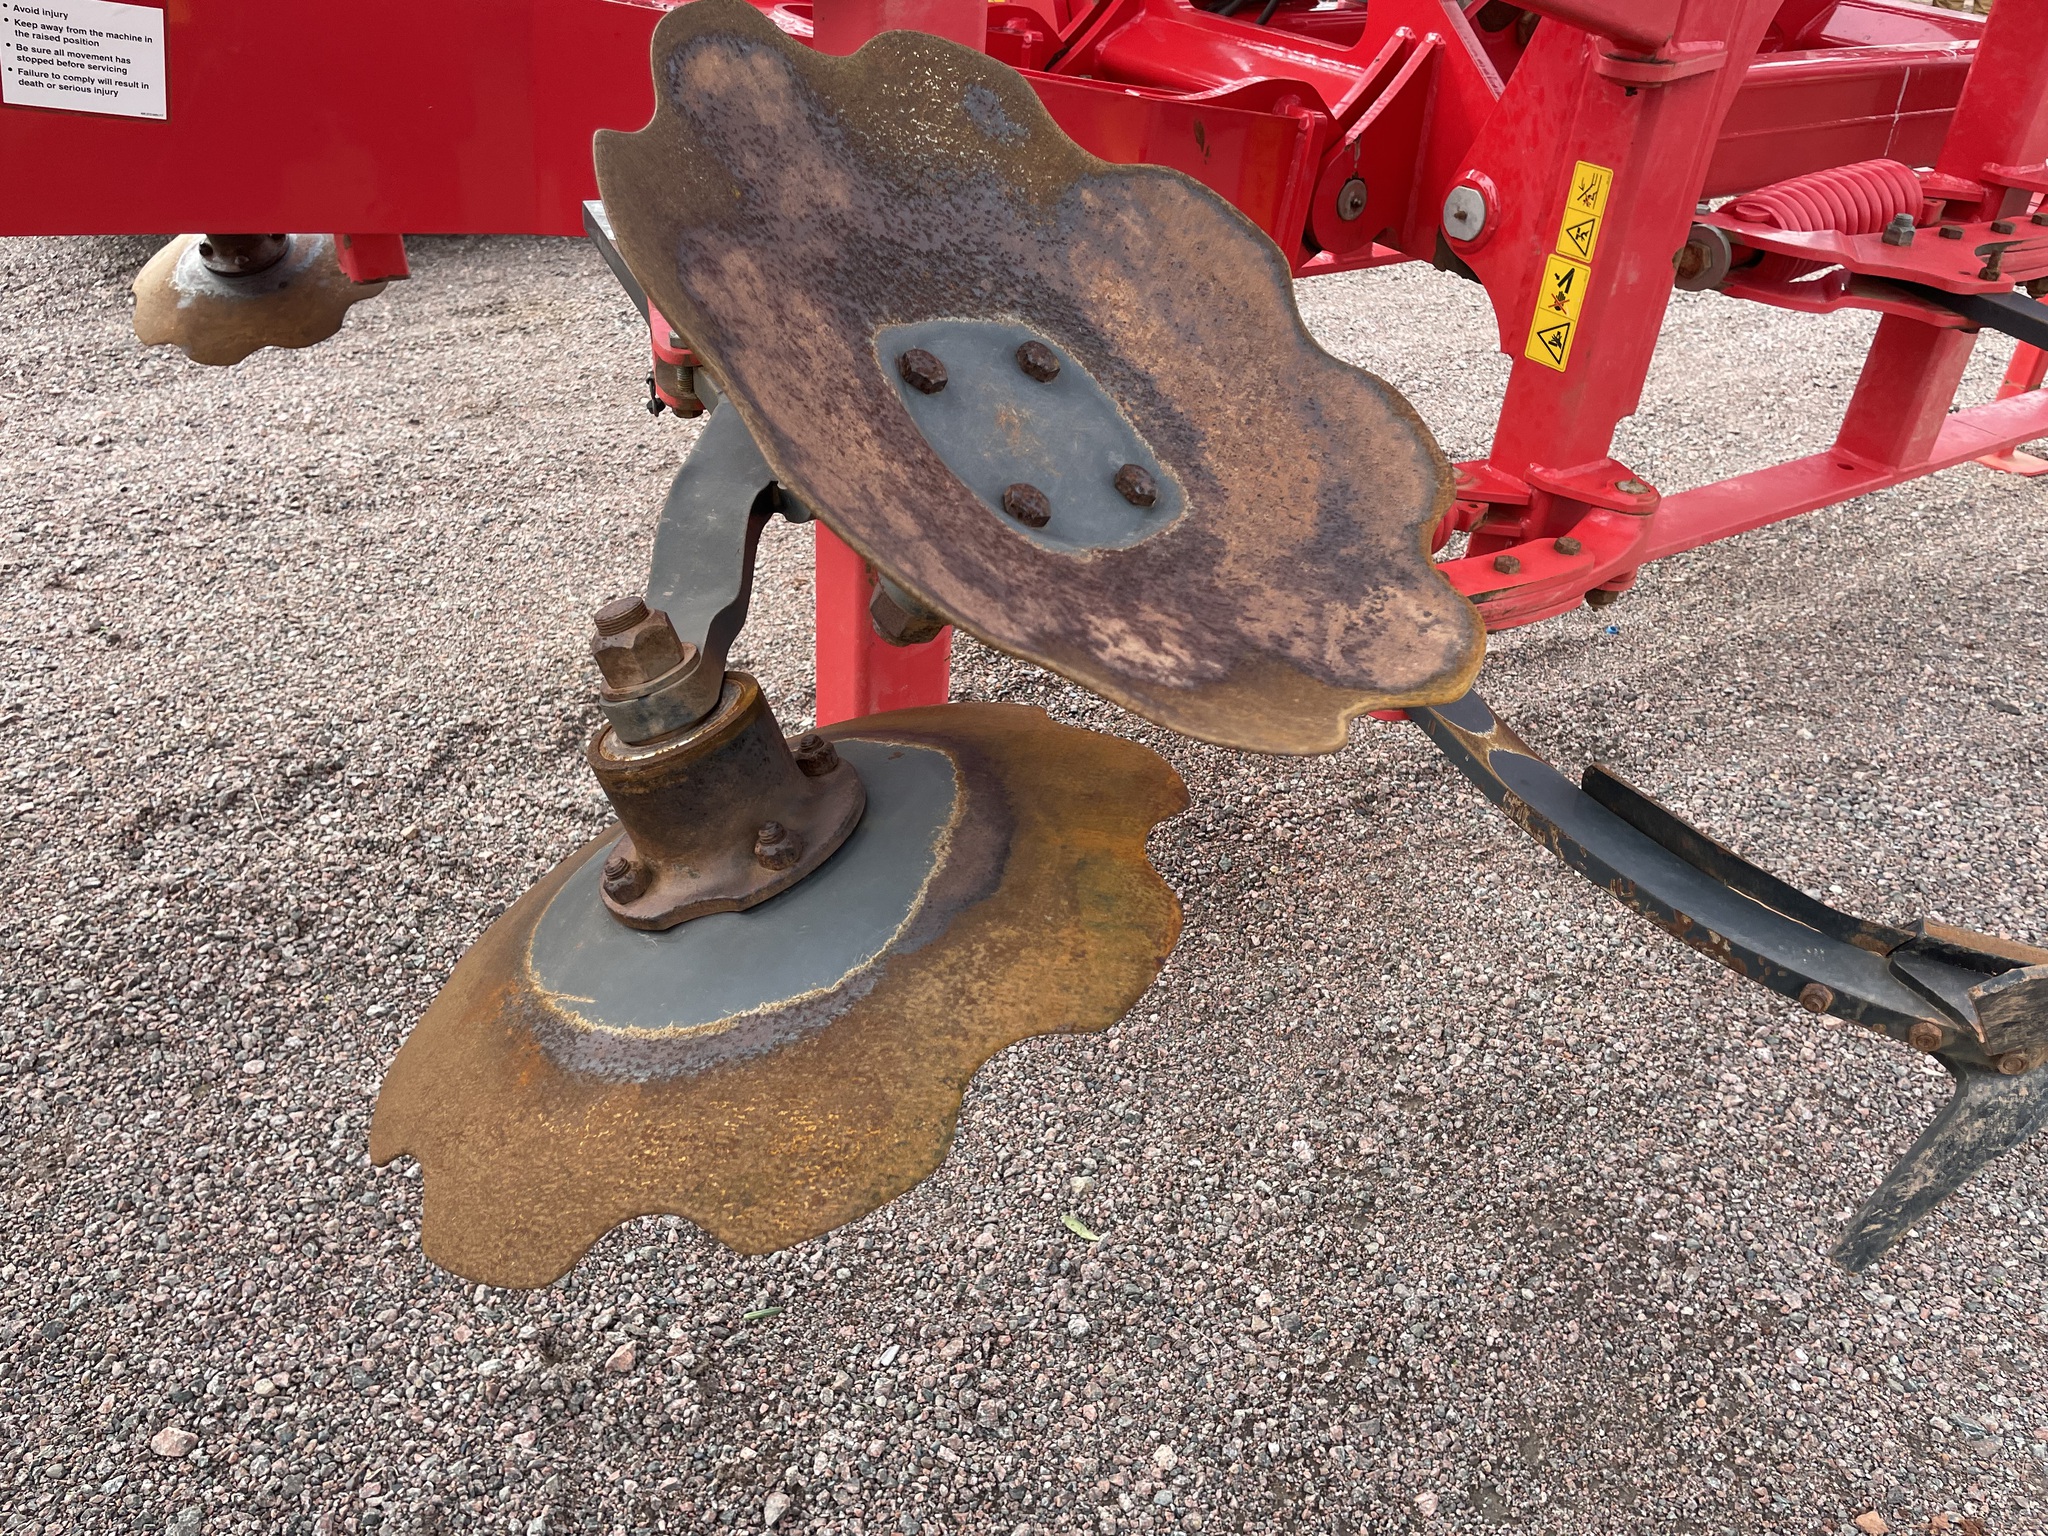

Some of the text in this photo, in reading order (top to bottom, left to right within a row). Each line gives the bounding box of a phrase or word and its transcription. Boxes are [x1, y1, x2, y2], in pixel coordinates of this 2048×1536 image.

[13, 4, 69, 20] Avoid injury
[14, 18, 153, 43] Keep away from the machine in
[14, 29, 100, 47] the raised position
[16, 43, 29, 52] Be
[31, 46, 52, 55] sure
[67, 51, 113, 63] movement
[115, 55, 131, 65] has
[16, 54, 128, 76] stopped before servicing
[17, 67, 49, 78] Failure
[62, 74, 96, 85] comply
[97, 77, 113, 85] will
[114, 80, 139, 89] result
[141, 81, 149, 90] in
[18, 78, 44, 88] death
[58, 83, 92, 93] serious
[93, 86, 119, 98] injury
